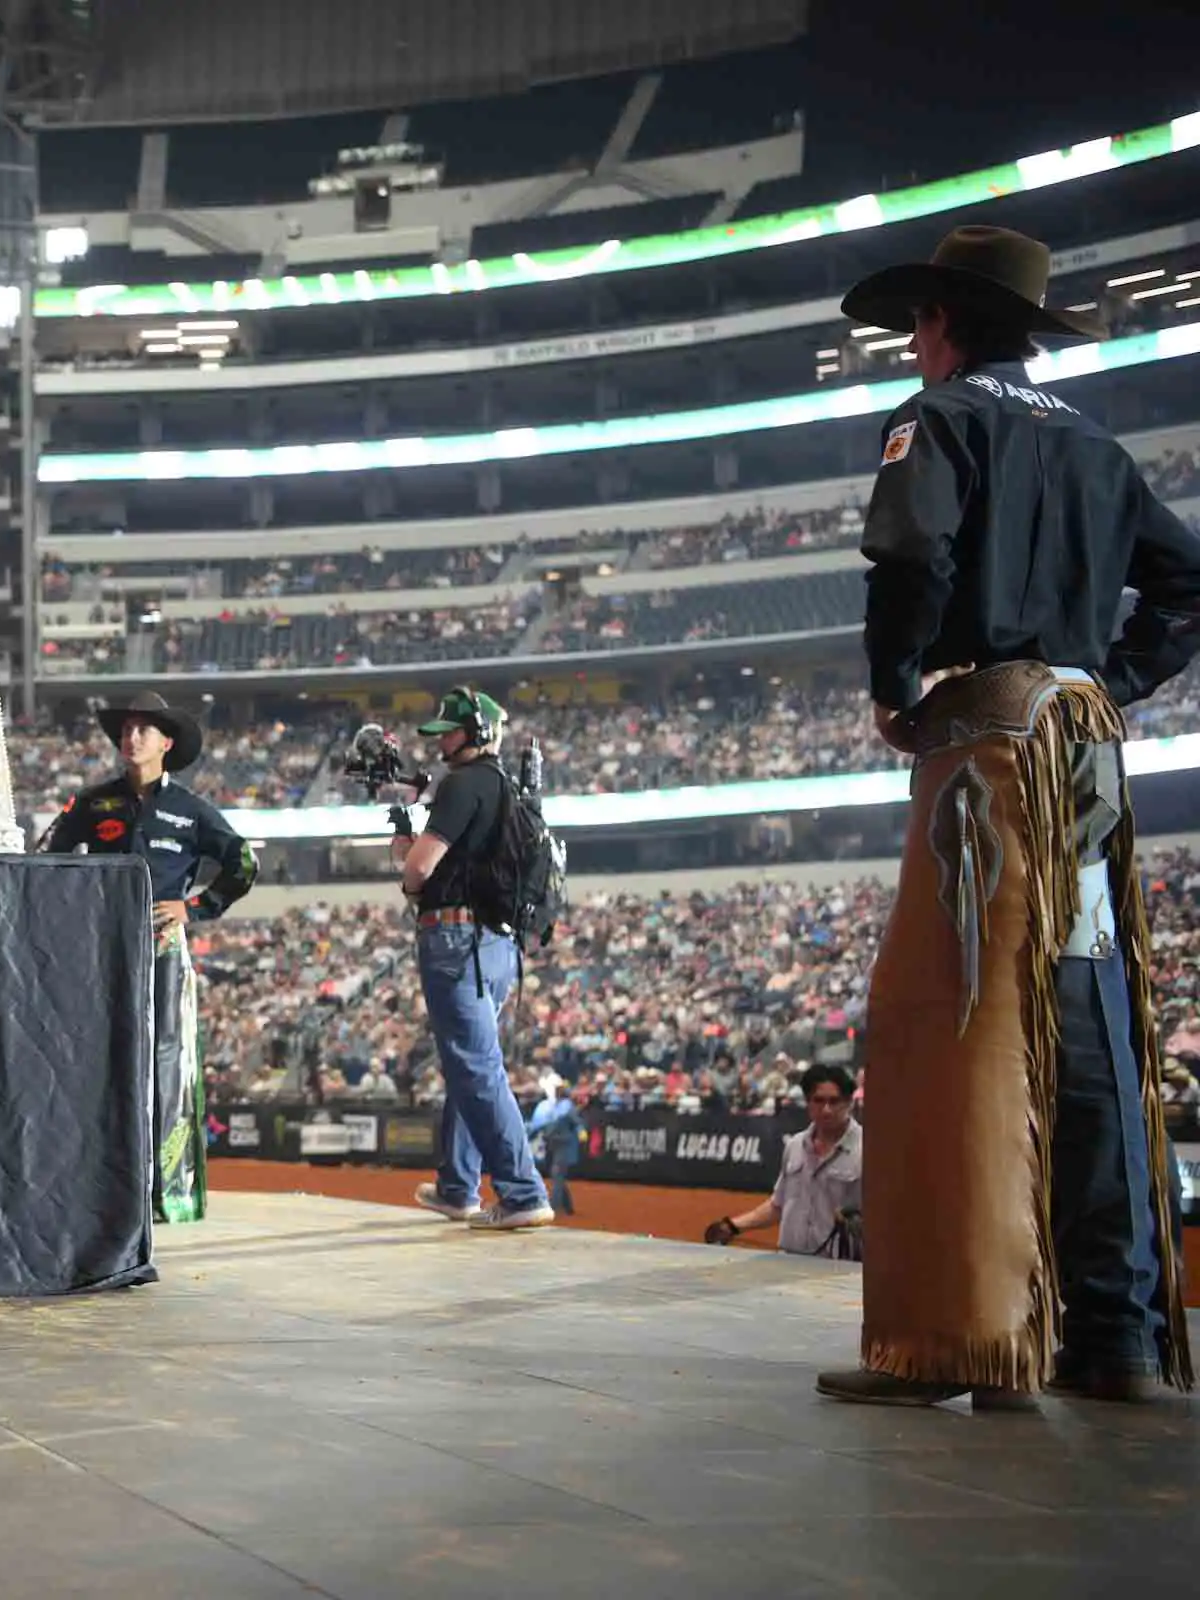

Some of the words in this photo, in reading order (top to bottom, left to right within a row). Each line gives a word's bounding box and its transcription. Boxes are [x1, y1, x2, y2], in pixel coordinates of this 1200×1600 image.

[1003, 382, 1080, 415] ARIA
[677, 1132, 729, 1161] LUCAS
[731, 1135, 762, 1163] OIL
